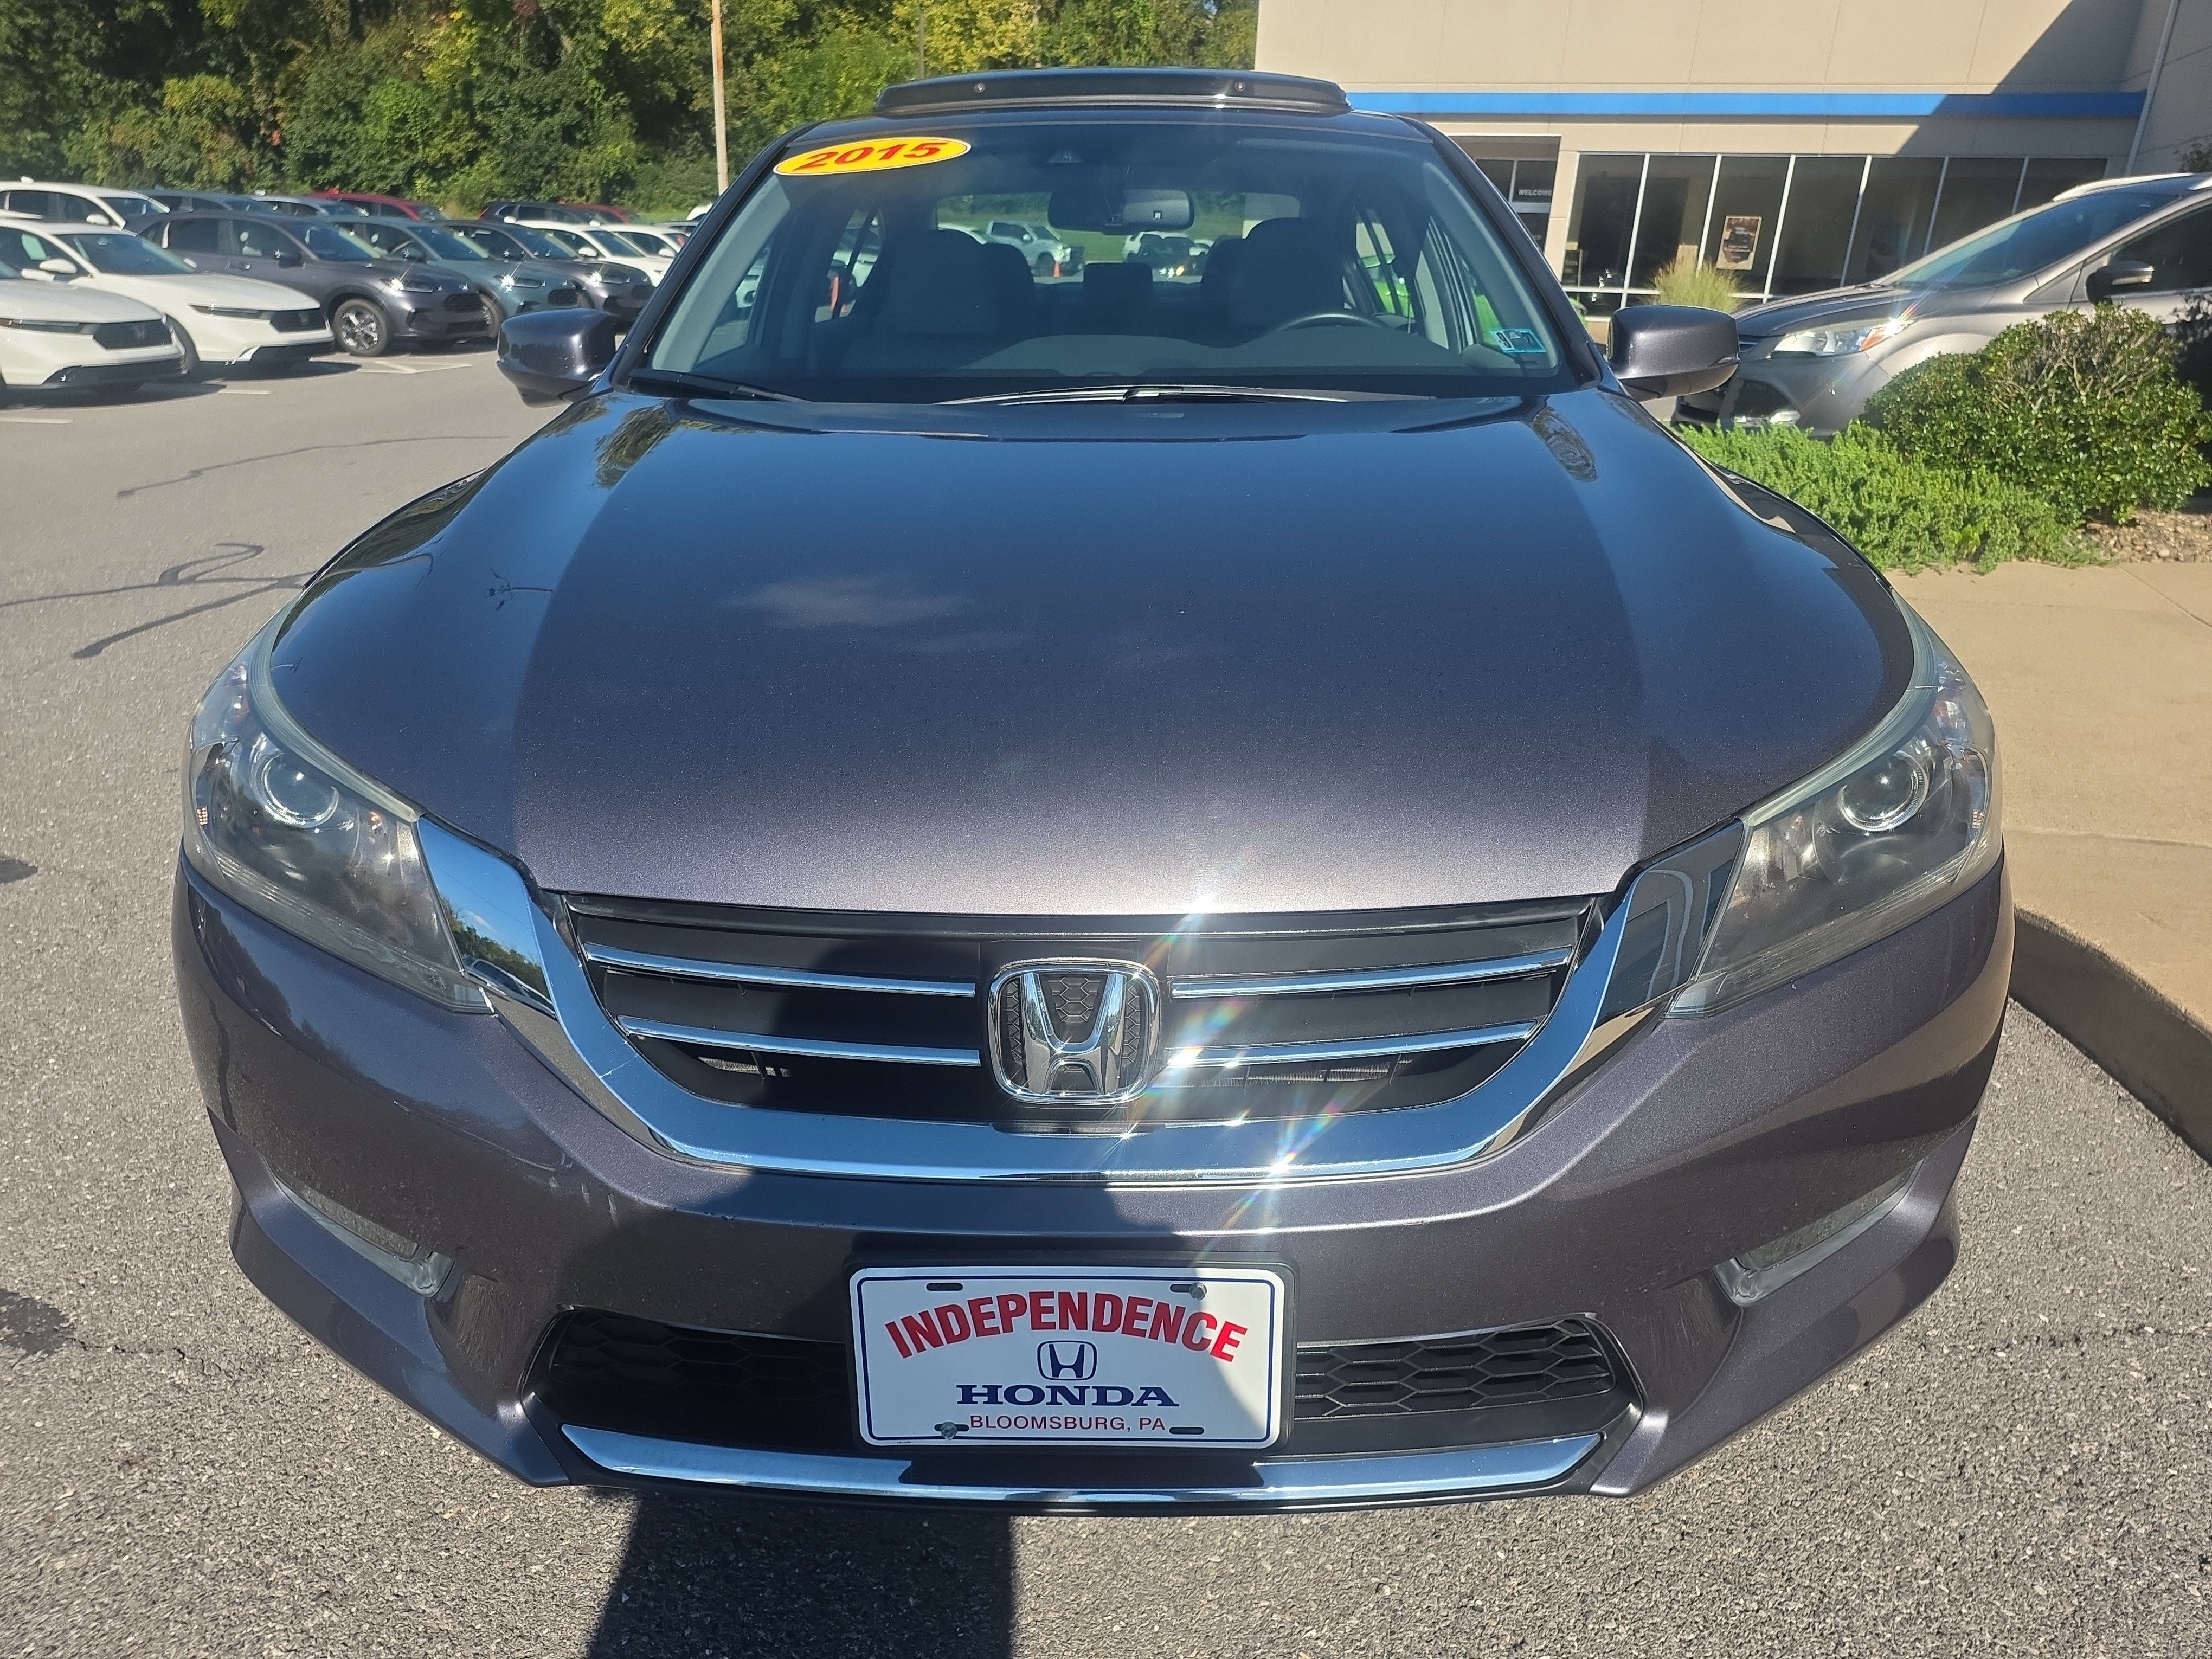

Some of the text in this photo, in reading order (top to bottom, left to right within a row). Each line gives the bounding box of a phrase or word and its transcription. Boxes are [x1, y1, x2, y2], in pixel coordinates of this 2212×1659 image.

[792, 142, 949, 171] 2015
[885, 1291, 1248, 1362] INDEPENDENCE
[956, 1384, 1179, 1407] HONDA
[970, 1415, 1166, 1433] BLOOMSBURG, PA
